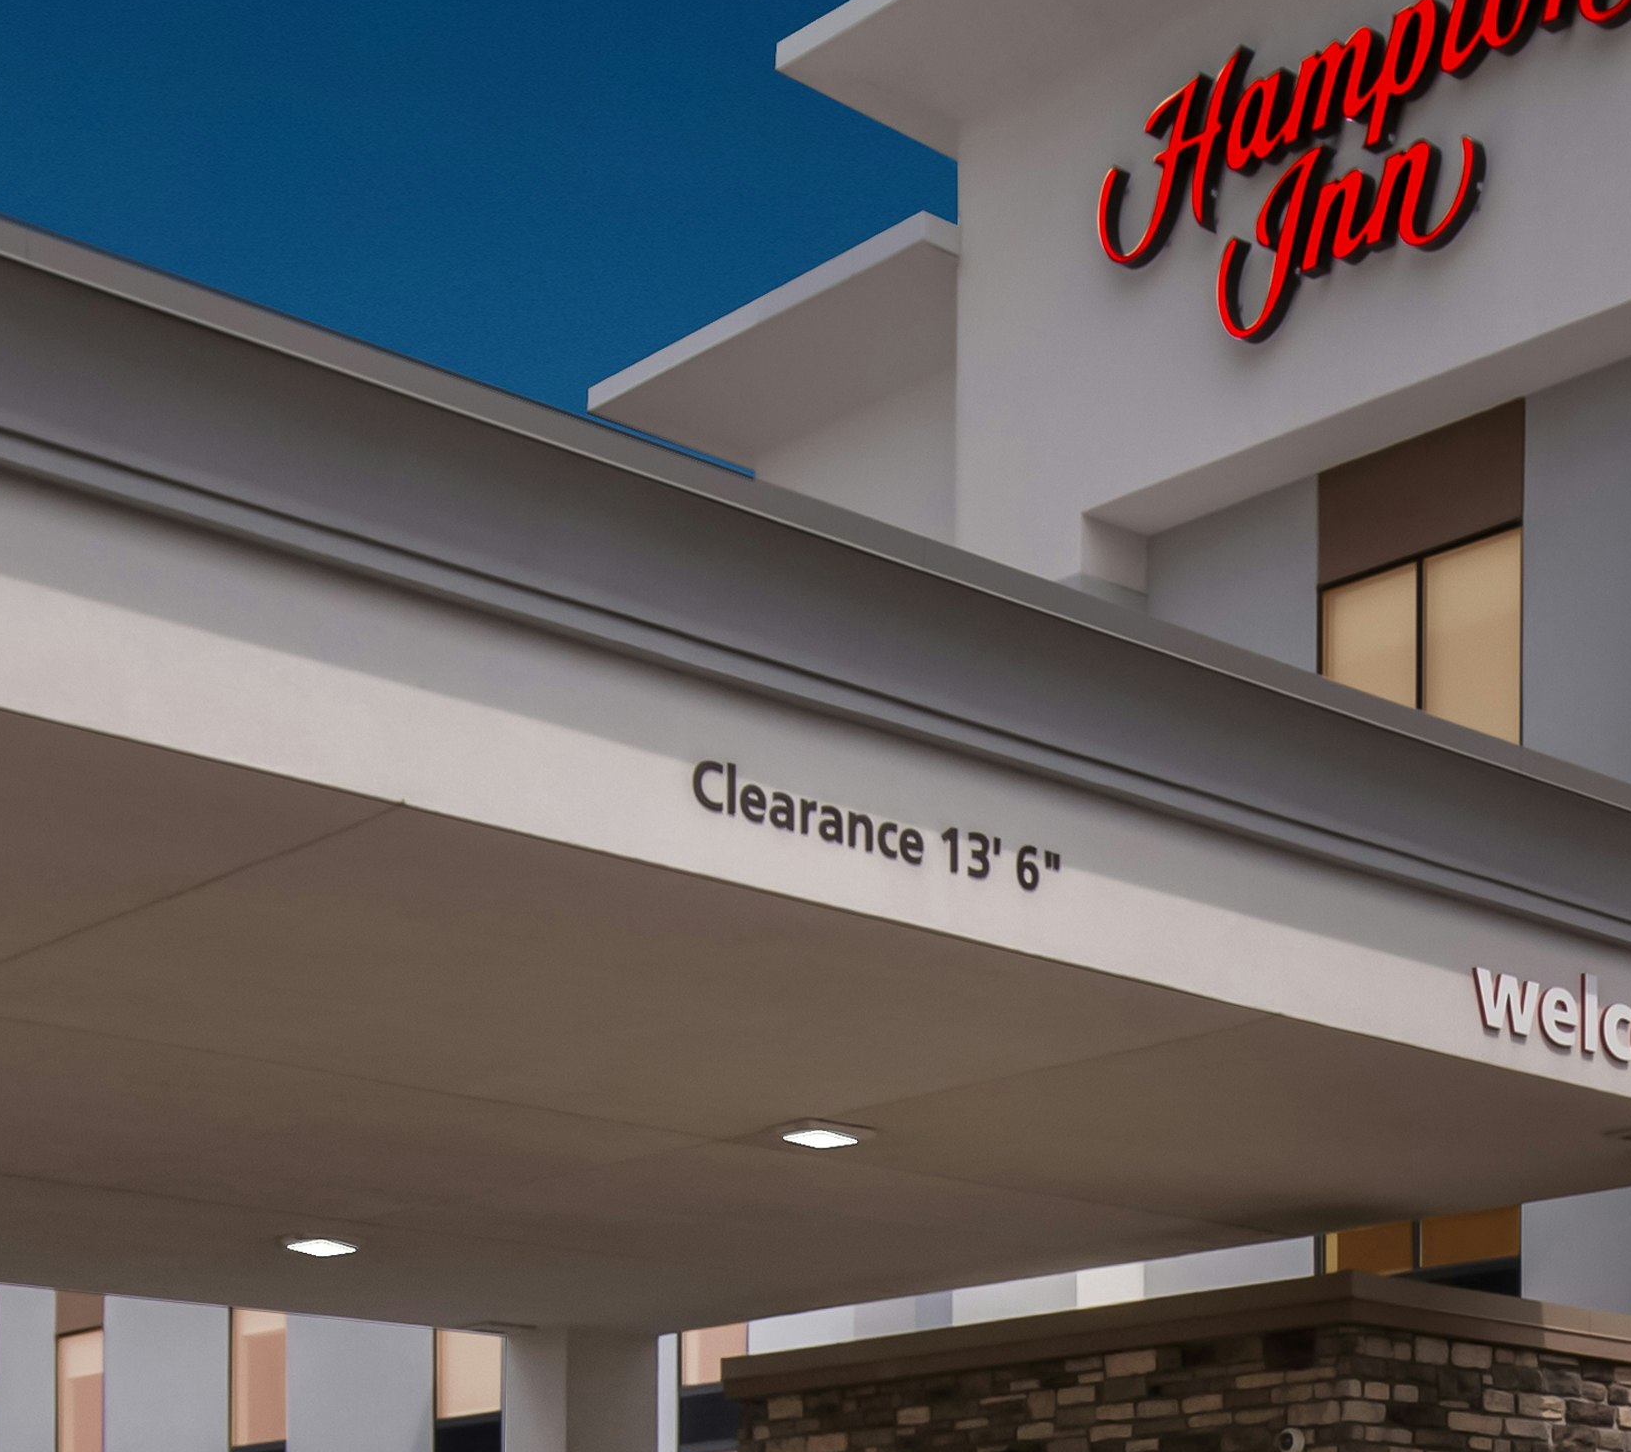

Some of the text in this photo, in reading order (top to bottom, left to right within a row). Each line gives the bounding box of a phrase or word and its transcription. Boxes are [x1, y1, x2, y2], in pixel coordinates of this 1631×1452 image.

[1216, 135, 1485, 341] Inn
[691, 759, 1062, 892] Clearance 13' 6"
